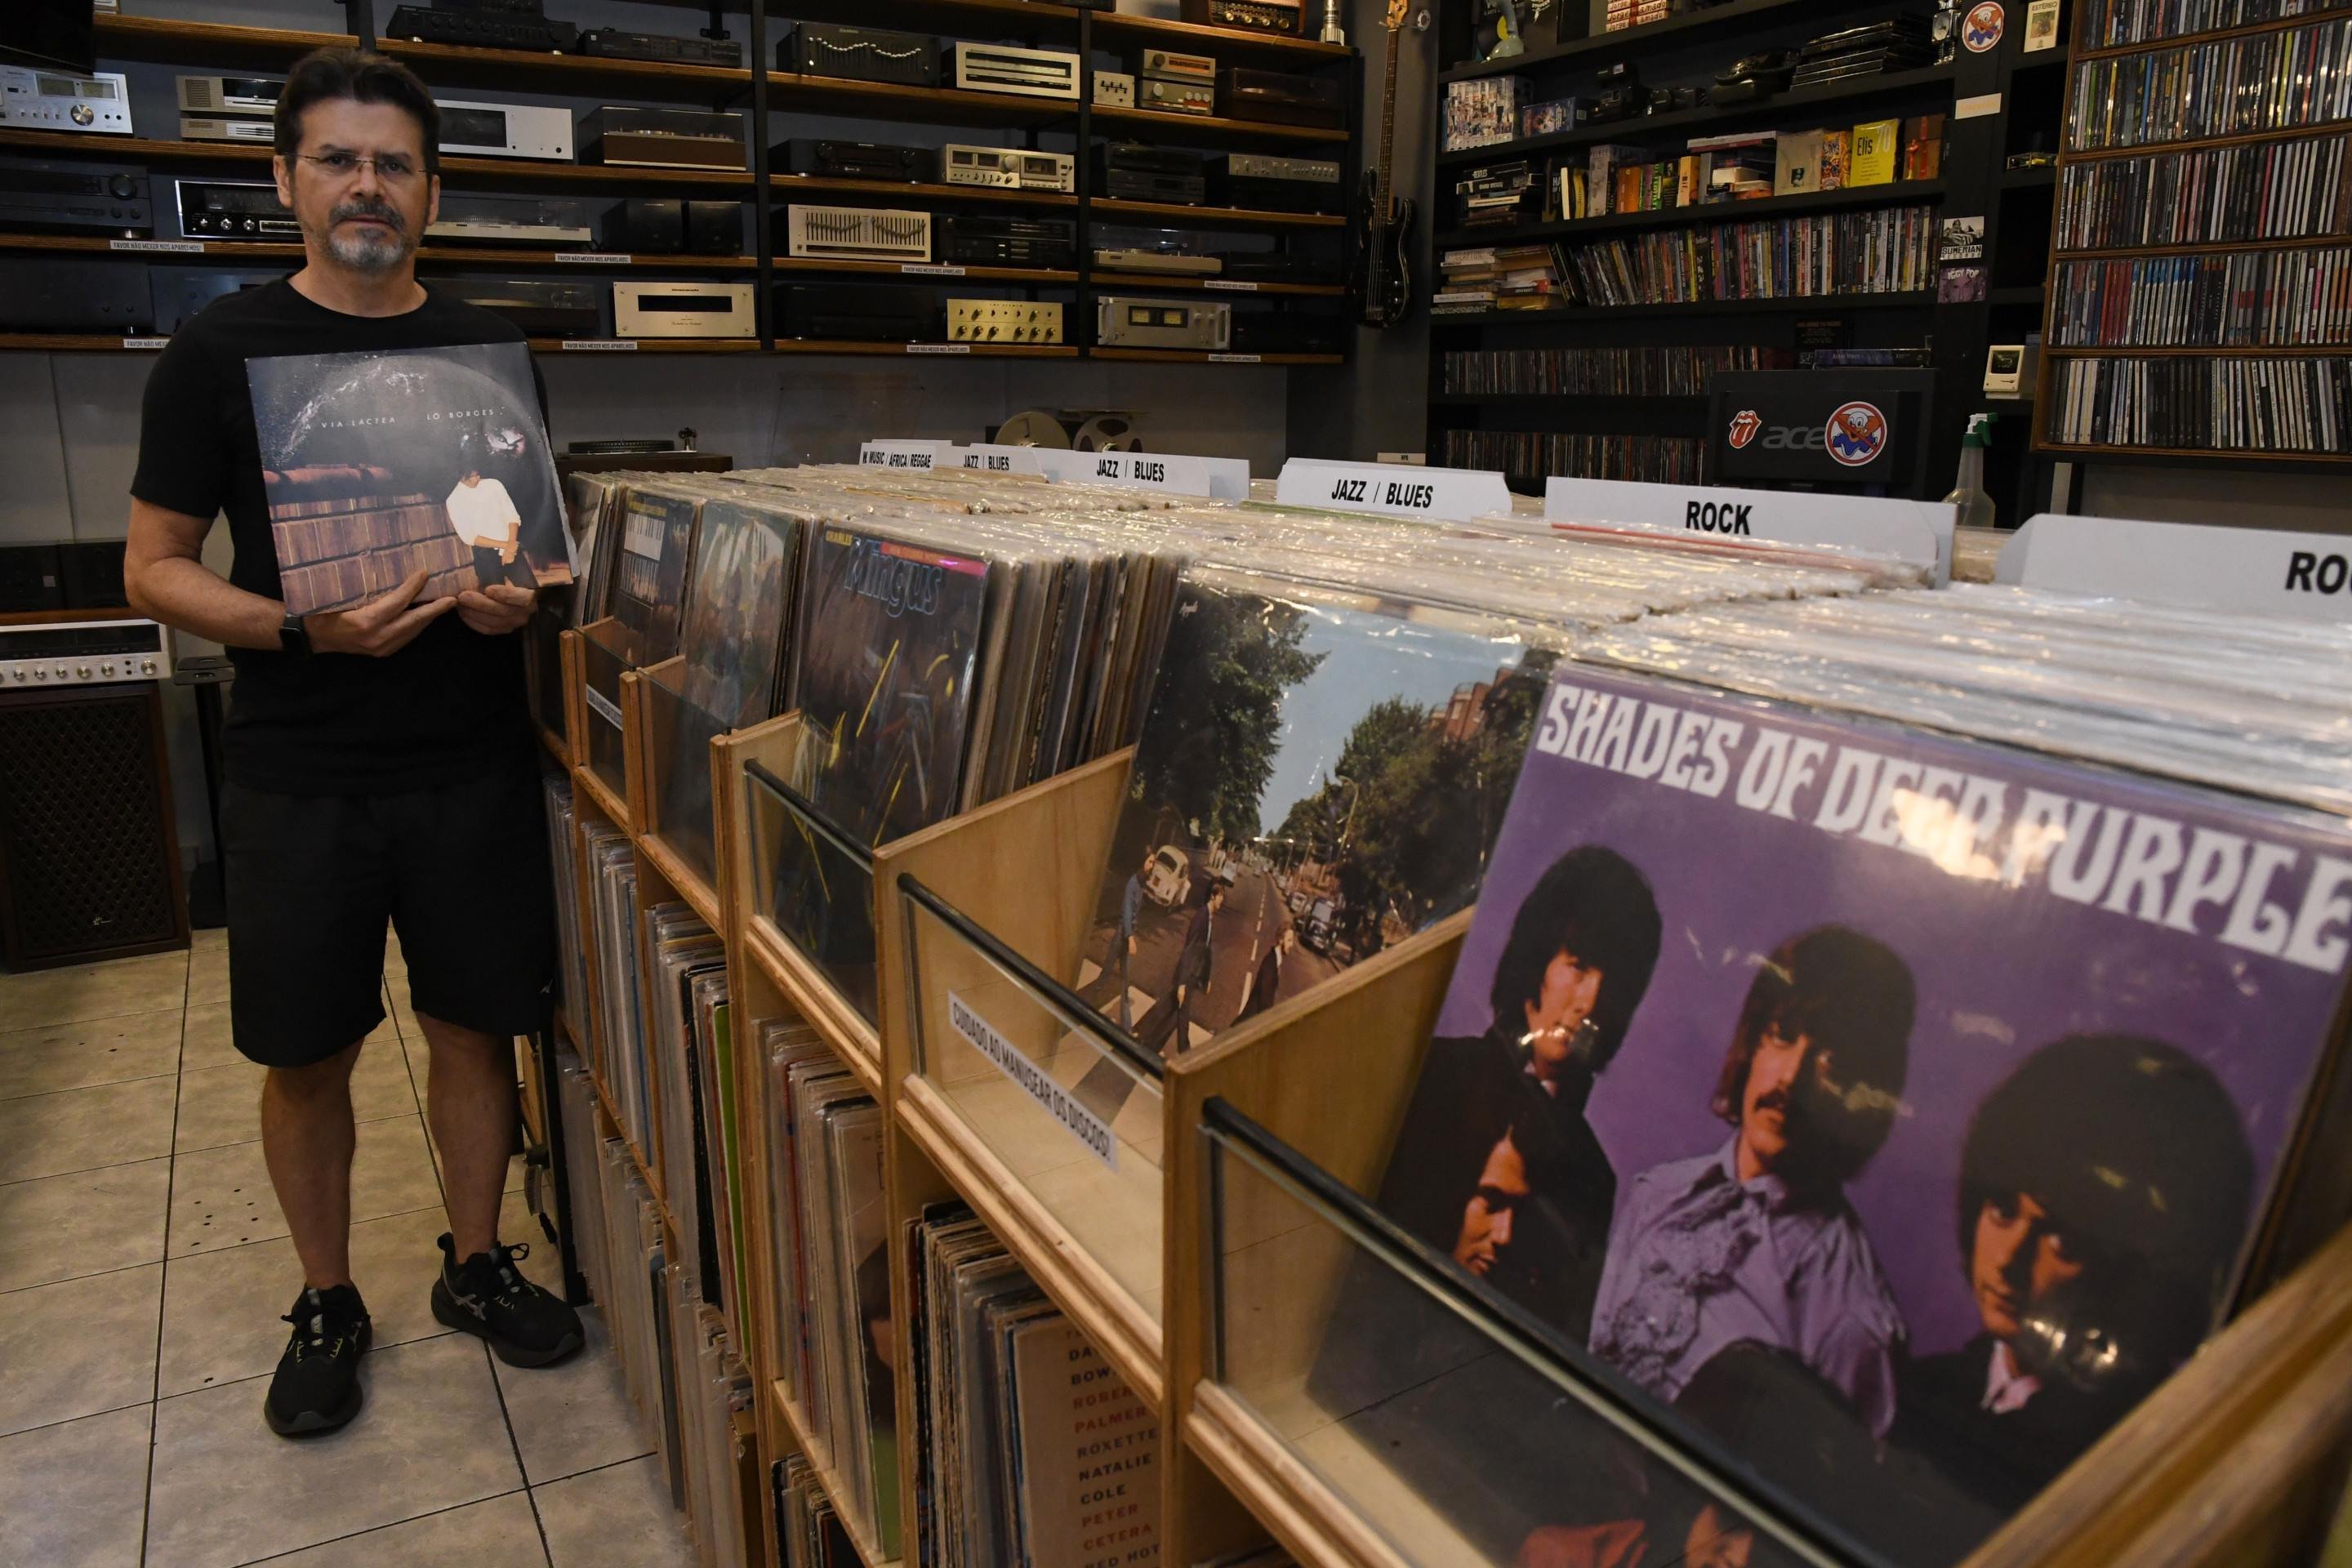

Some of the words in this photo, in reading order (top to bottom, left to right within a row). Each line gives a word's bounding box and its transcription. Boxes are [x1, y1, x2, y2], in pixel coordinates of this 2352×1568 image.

[1857, 137, 1873, 157] Elis
[448, 409, 494, 419] BORGES
[1762, 425, 1826, 449] ace
[868, 451, 884, 465] MUSIC
[910, 454, 932, 469] REGGAE
[964, 455, 979, 469] JAZZ
[988, 456, 1009, 470] BLUES
[1097, 459, 1119, 479] JAZZ
[1134, 461, 1165, 483] BLUES
[1331, 479, 1367, 501] JAZZ
[1386, 483, 1434, 508] BLUES
[1686, 501, 1753, 536] ROCK
[2285, 551, 2352, 595] RO
[1535, 684, 1744, 799] SHADES
[1736, 728, 1829, 820] OF
[2000, 786, 2352, 975] PURPLE
[1071, 1365, 1116, 1385] BOW
[1072, 1385, 1134, 1410] ROBER
[1075, 1406, 1147, 1433] PALMER
[1077, 1428, 1157, 1459] ROXETTE
[1079, 1453, 1152, 1481] NATALIE
[1080, 1484, 1126, 1504] COLE
[1082, 1503, 1138, 1527] PETER
[1084, 1523, 1152, 1551] CETERA
[1127, 1544, 1160, 1562] HOT
